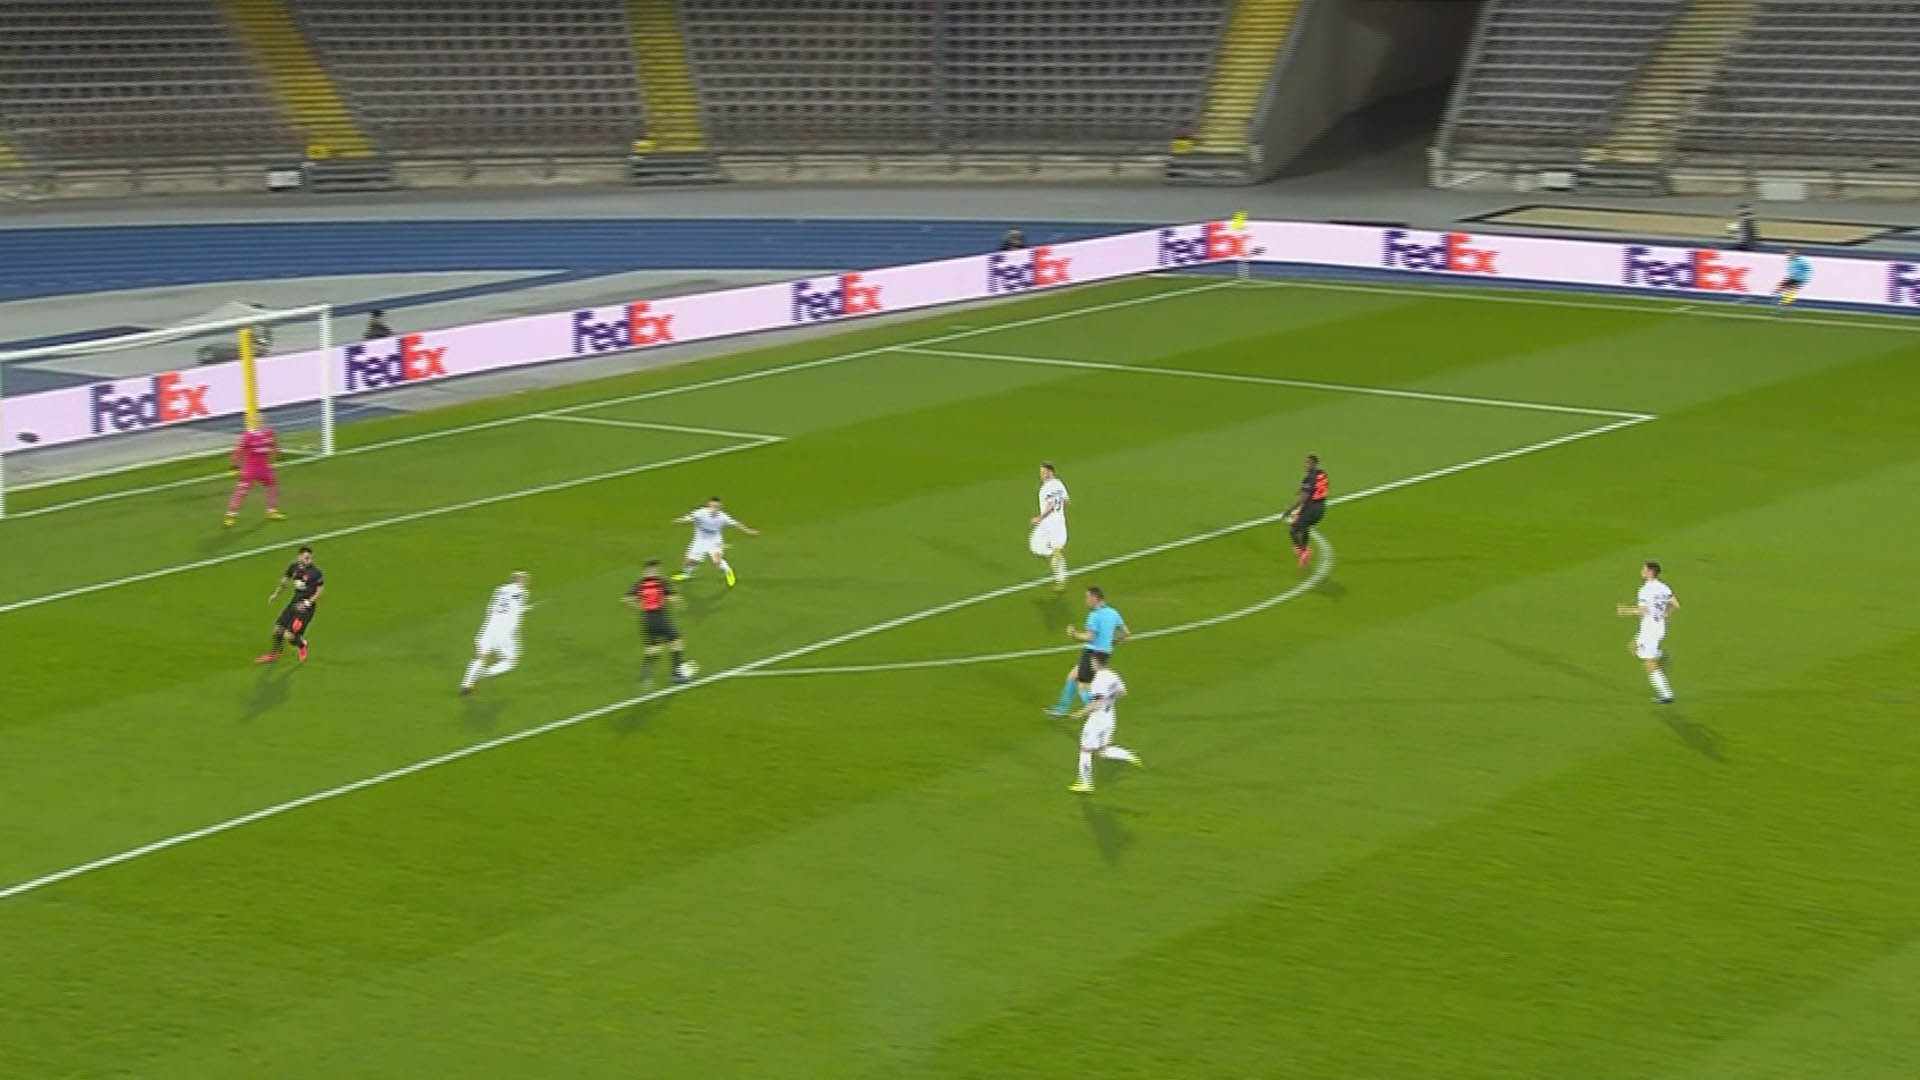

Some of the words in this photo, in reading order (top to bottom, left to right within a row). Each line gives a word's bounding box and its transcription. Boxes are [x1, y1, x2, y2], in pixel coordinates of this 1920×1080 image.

[1158, 220, 1253, 264] FedEx
[1382, 229, 1498, 274] FedEx
[986, 246, 1071, 293] FedEx
[1622, 246, 1749, 292] FedEx
[790, 271, 884, 322] FedEx
[572, 300, 675, 353] FedEx
[344, 333, 447, 390] FedEx
[90, 372, 209, 433] FedEx
